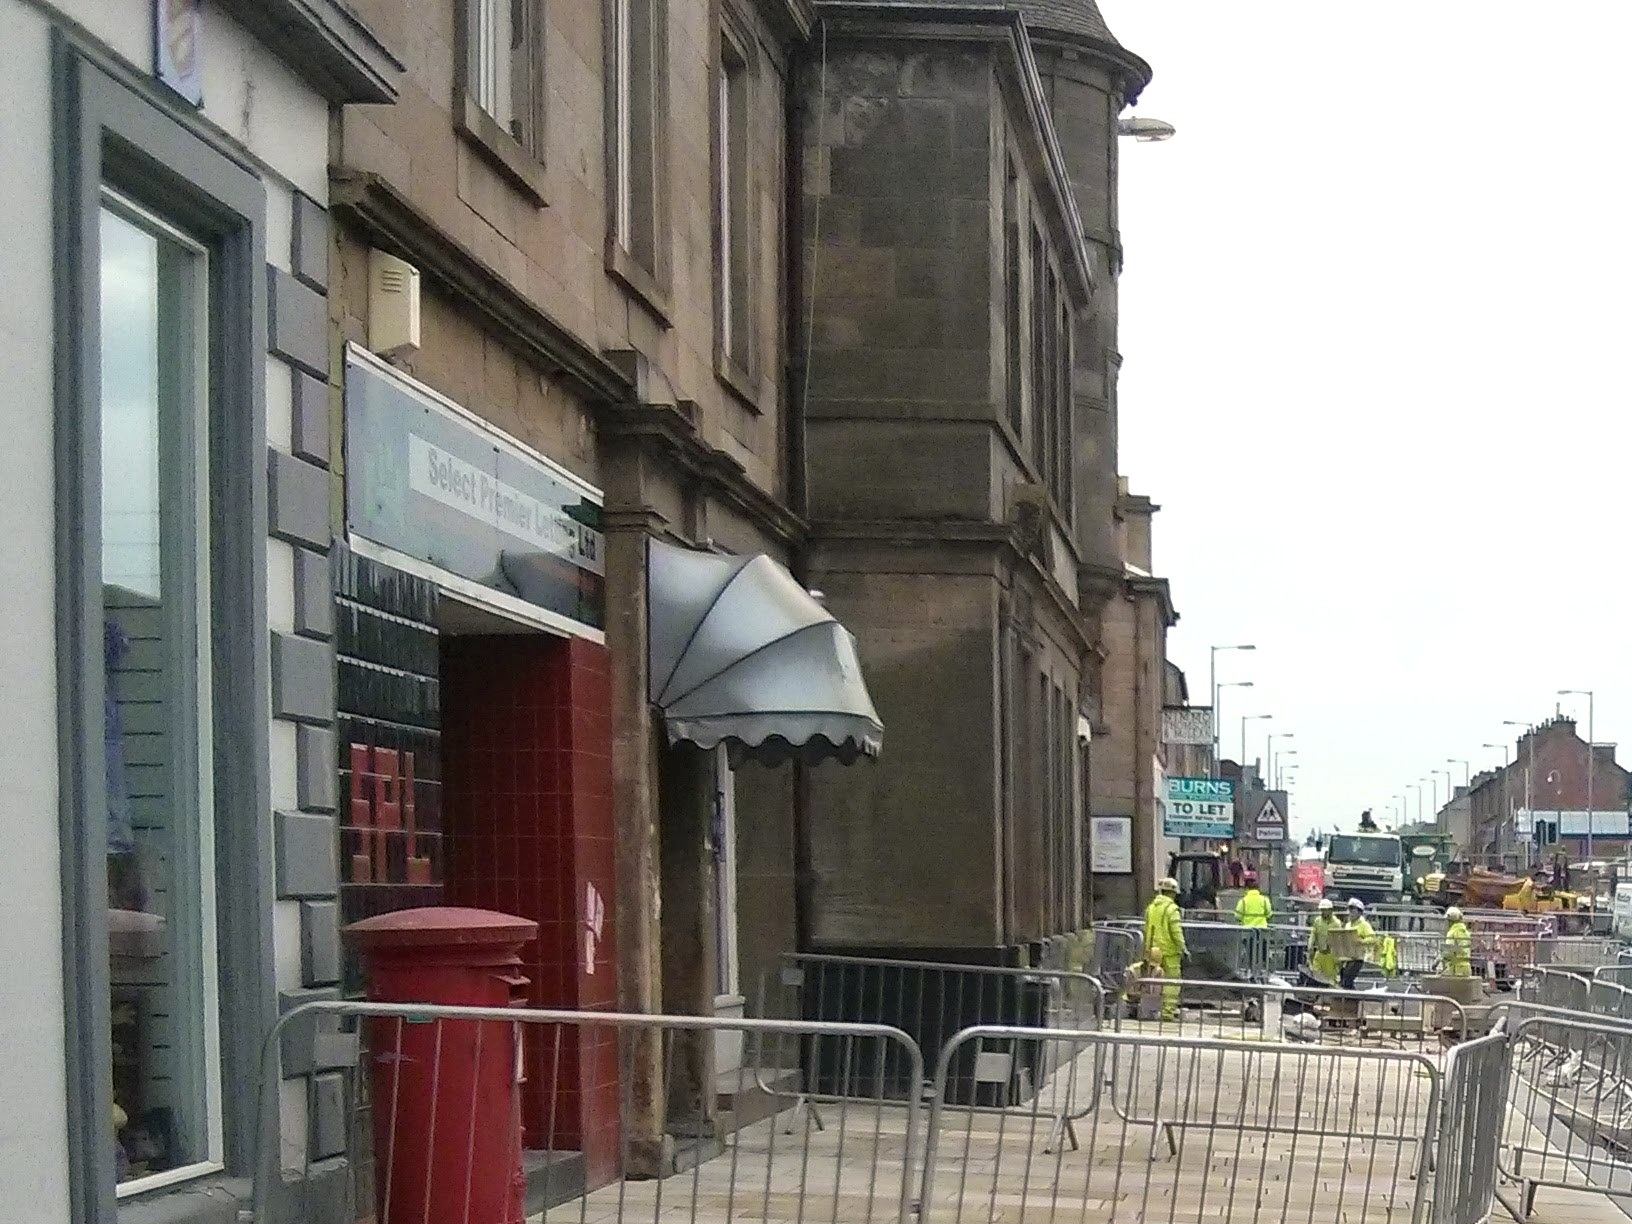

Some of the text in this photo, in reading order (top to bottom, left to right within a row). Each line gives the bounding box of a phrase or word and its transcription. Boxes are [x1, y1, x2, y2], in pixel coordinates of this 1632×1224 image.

[428, 447, 476, 505] Select
[480, 474, 531, 530] Premier
[578, 524, 597, 561] Ltd
[1169, 779, 1231, 795] BURNS
[1173, 802, 1226, 816] TO LET
